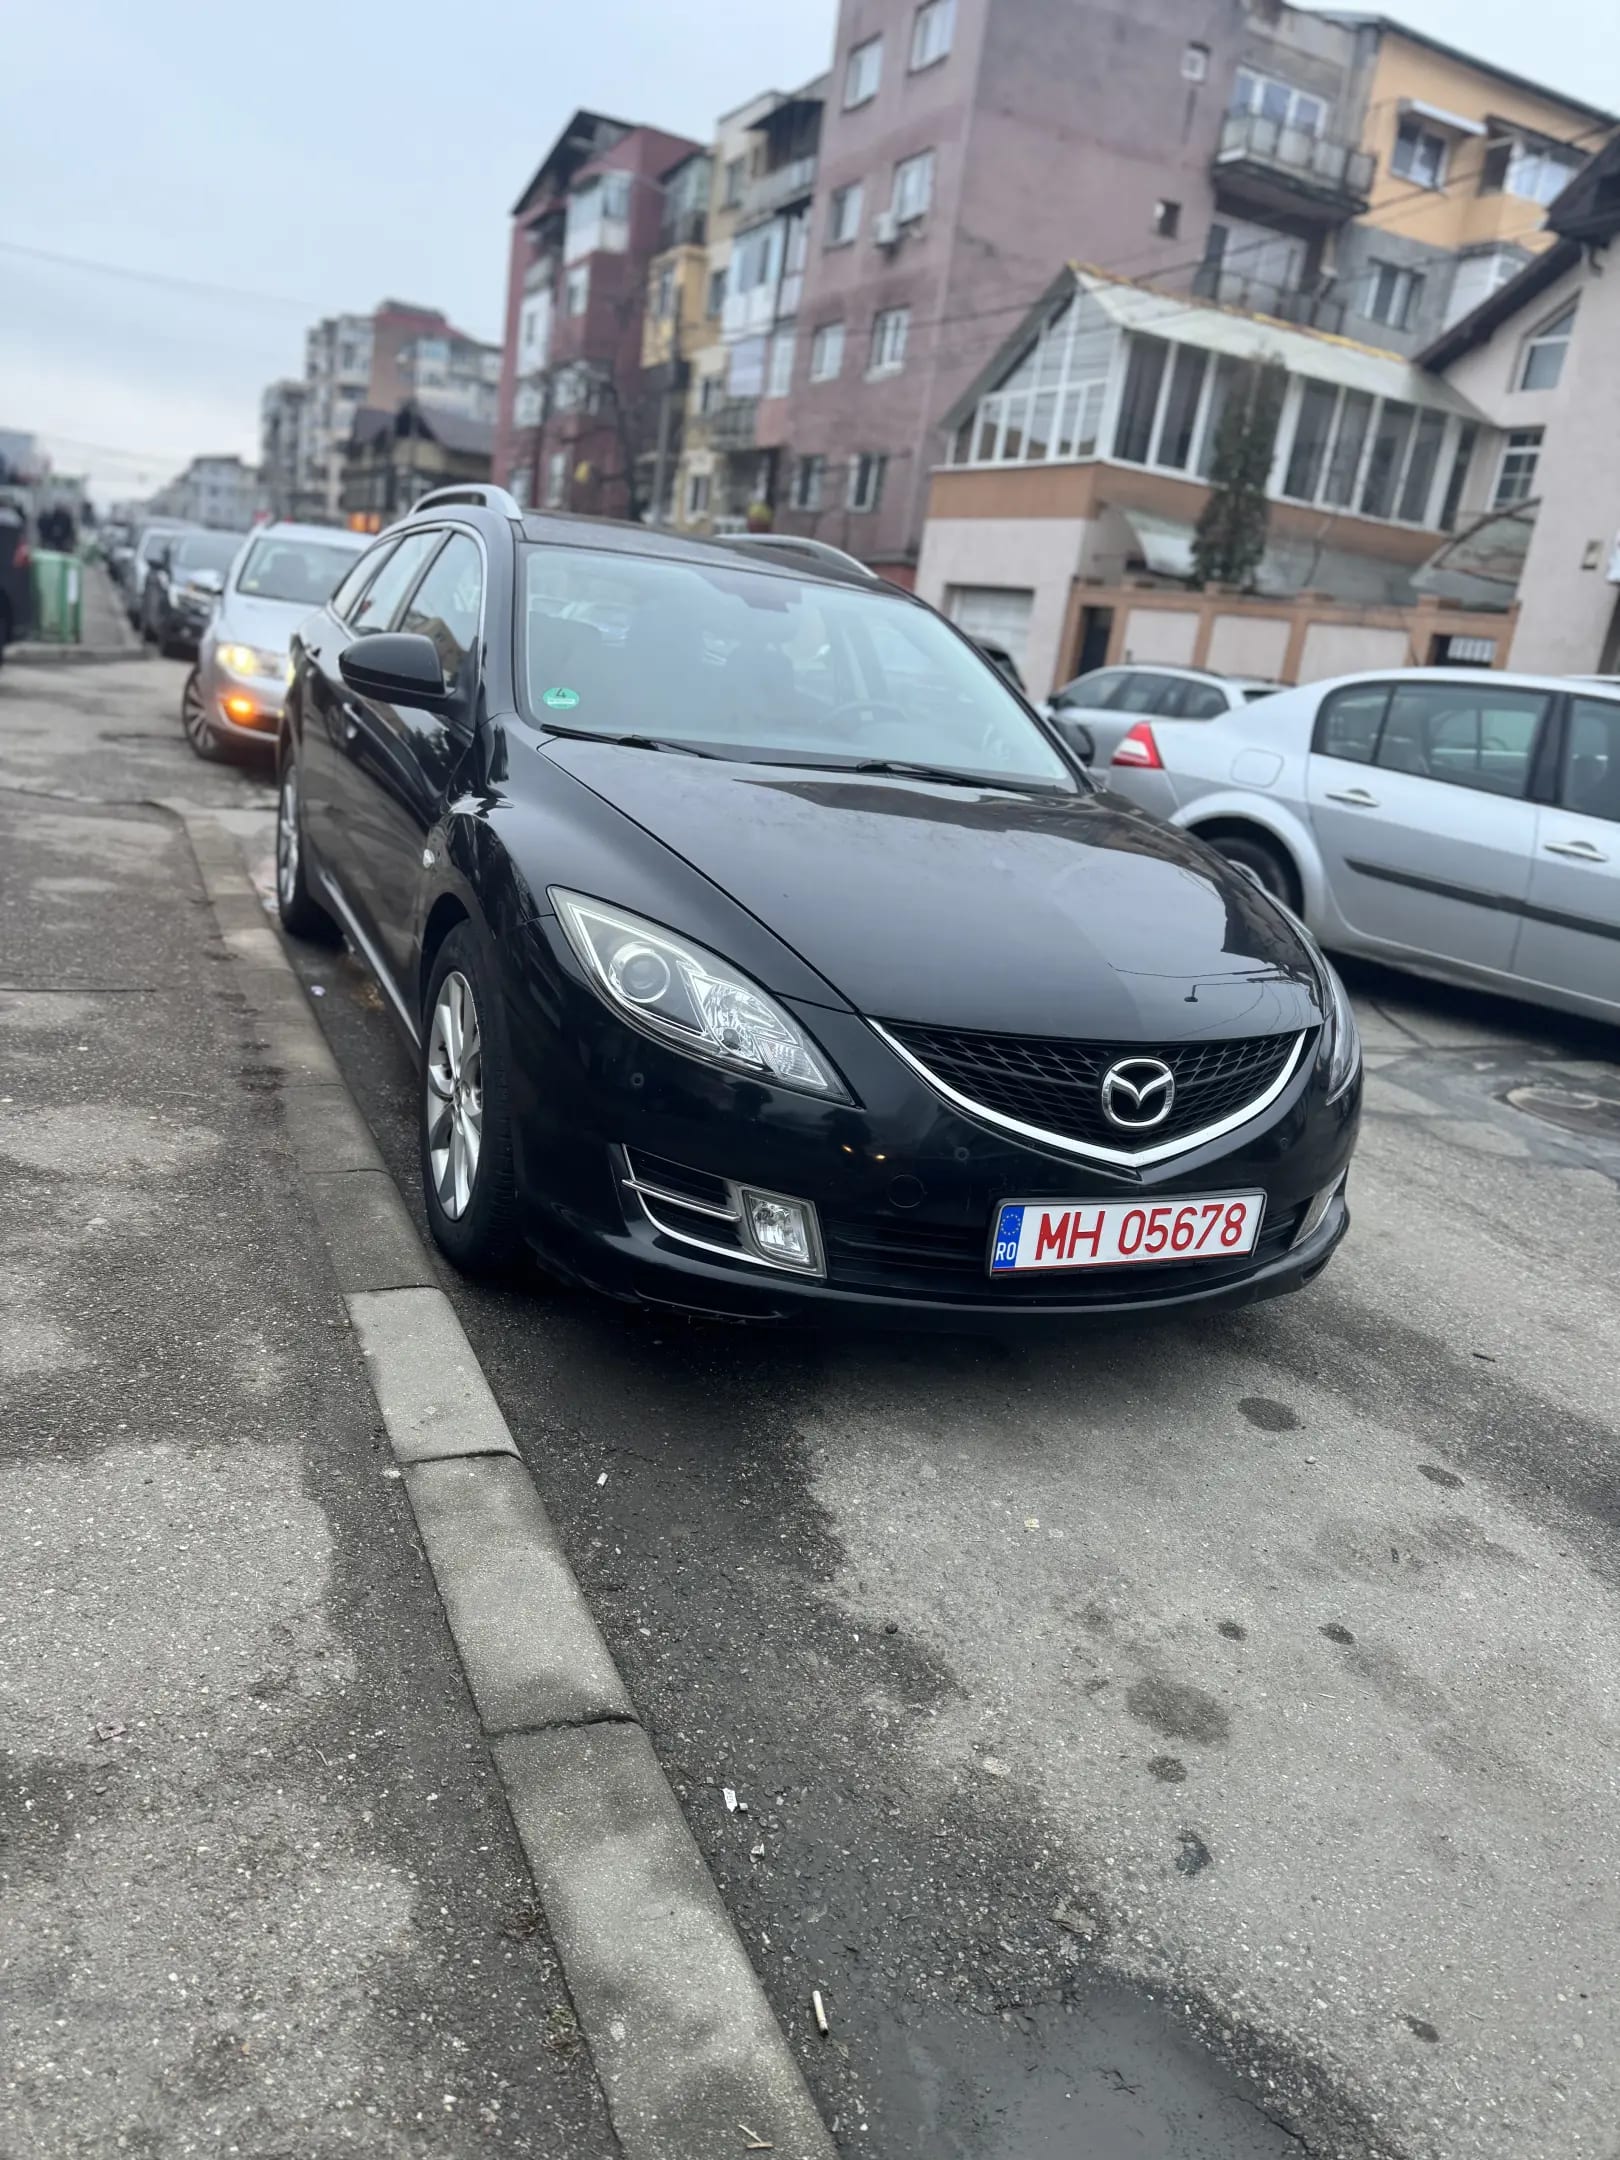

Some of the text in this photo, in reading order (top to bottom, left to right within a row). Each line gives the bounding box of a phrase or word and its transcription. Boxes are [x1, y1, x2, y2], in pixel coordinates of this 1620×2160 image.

[556, 688, 567, 698] 4
[1034, 1202, 1247, 1260] MH 05678
[995, 1241, 1017, 1261] RO
